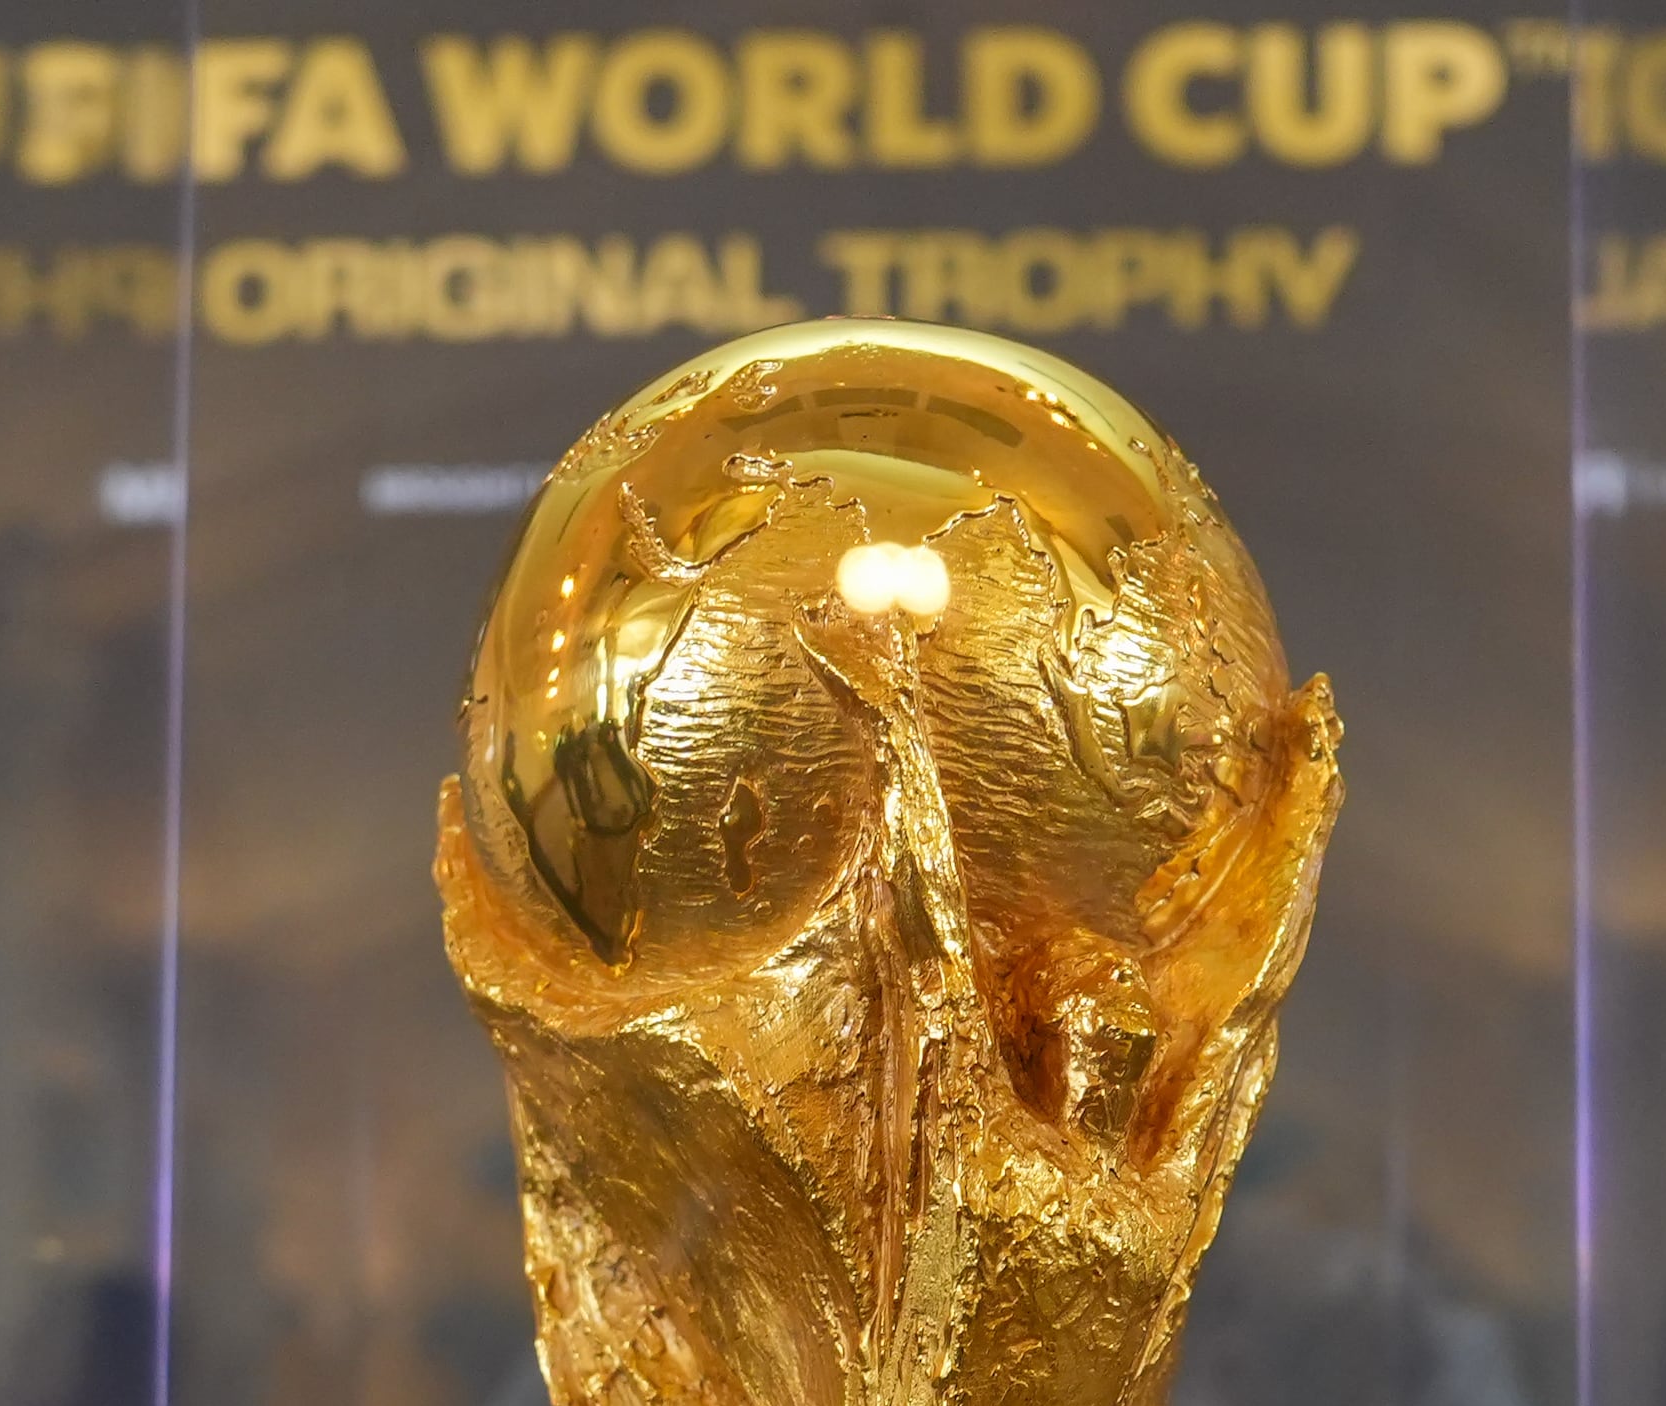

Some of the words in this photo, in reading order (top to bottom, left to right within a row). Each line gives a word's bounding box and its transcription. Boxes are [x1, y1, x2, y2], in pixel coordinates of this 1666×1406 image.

[17, 38, 407, 184] FIFA
[421, 27, 1103, 178] WORLD
[199, 234, 803, 343] ORIGINAL
[821, 224, 1360, 336] TROPHY
